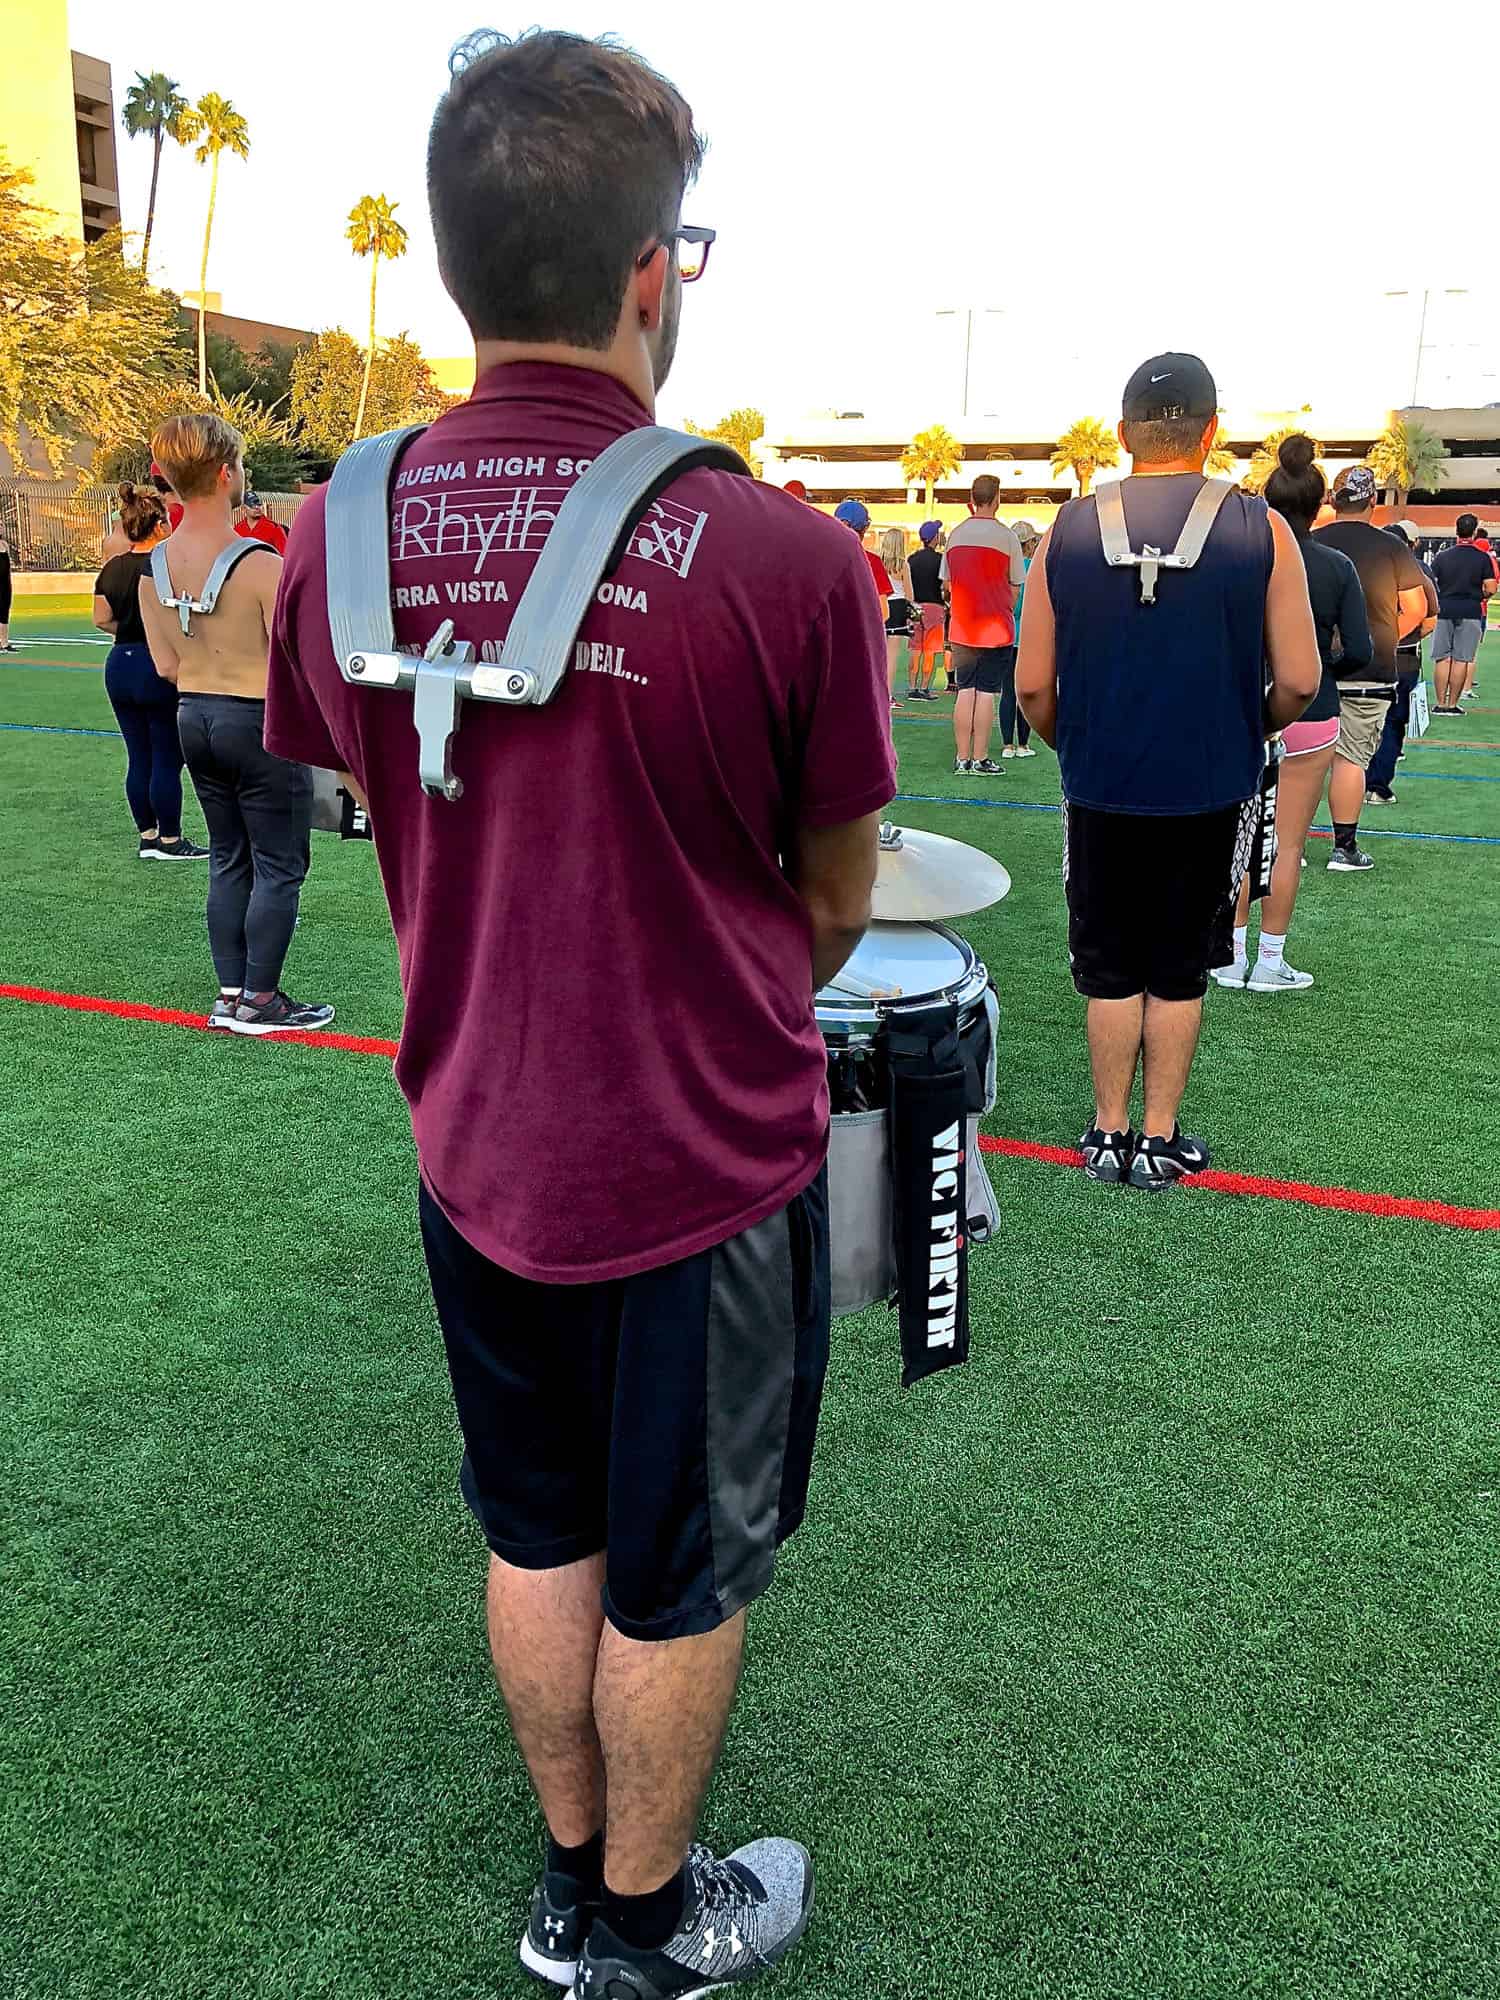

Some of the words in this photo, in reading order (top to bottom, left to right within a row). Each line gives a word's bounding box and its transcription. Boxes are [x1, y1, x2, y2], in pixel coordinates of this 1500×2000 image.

[395, 461, 466, 490] BUENA
[475, 456, 546, 479] HIGH
[391, 584, 440, 609] RRA
[445, 580, 509, 603] VISTA
[932, 1119, 964, 1202] VIC
[927, 1210, 964, 1348] FIRTH
